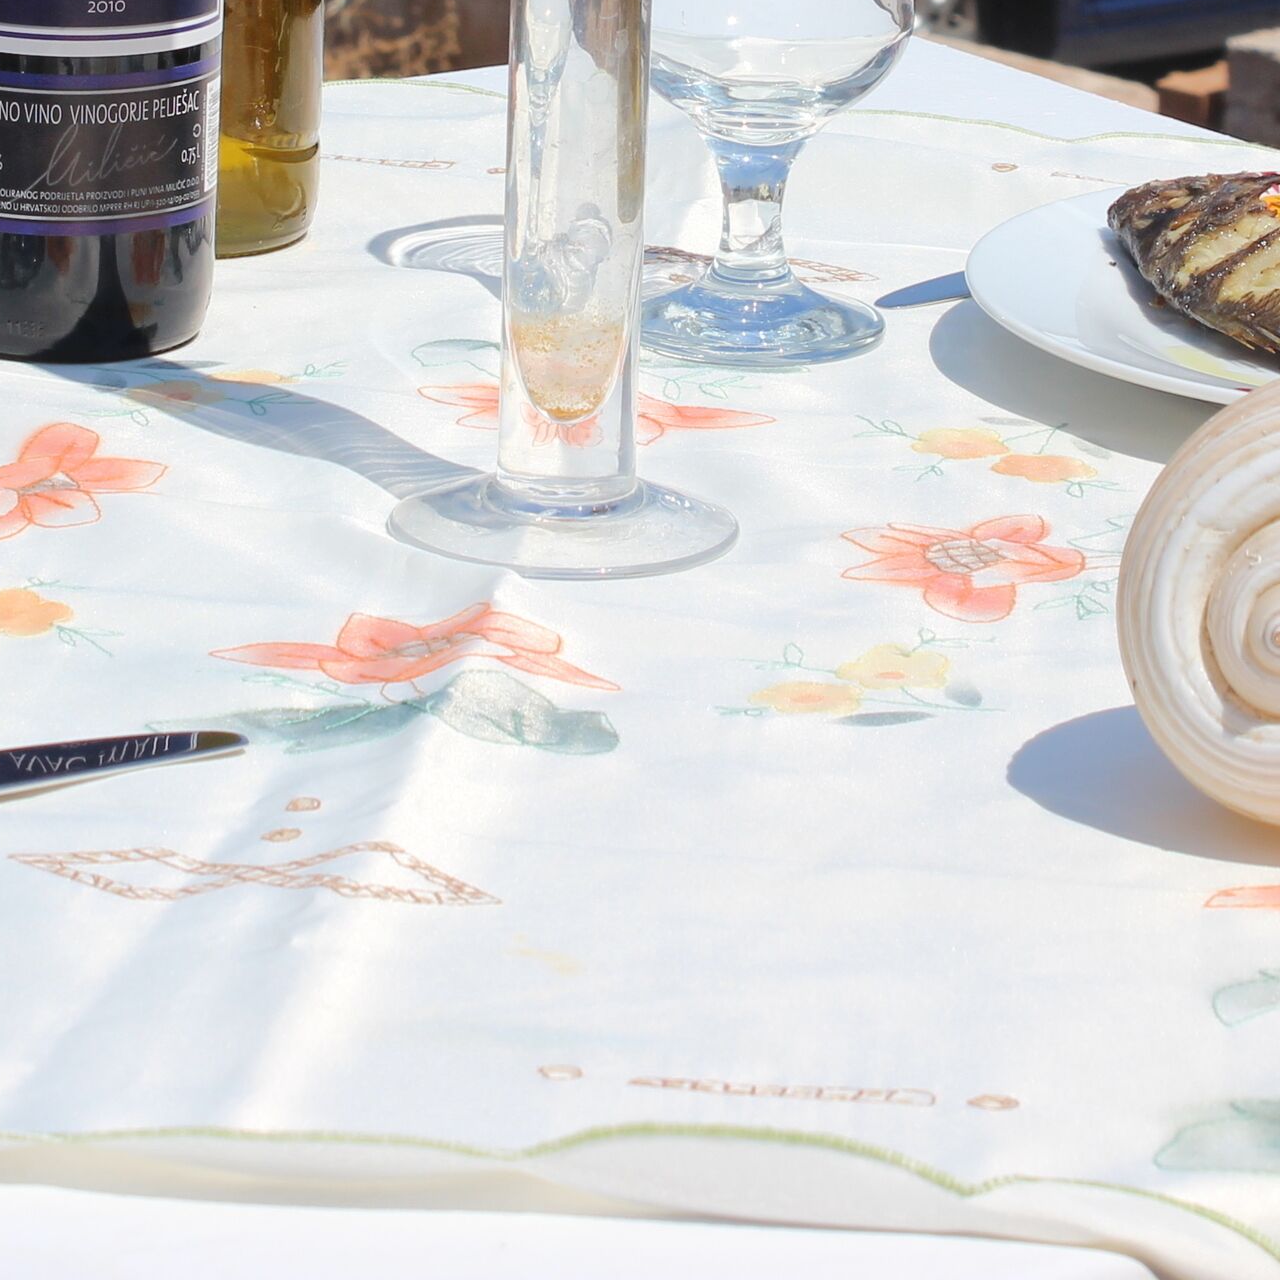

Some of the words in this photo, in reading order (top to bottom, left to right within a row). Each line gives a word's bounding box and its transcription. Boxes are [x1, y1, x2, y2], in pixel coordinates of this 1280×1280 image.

[87, 0, 126, 13] 2010
[23, 103, 62, 125] VINO
[70, 100, 149, 125] VINOGORJE
[152, 88, 200, 119] PELJEŠAC
[40, 191, 85, 201] PODRIJETLA
[19, 201, 61, 214] HRVATSKOJ
